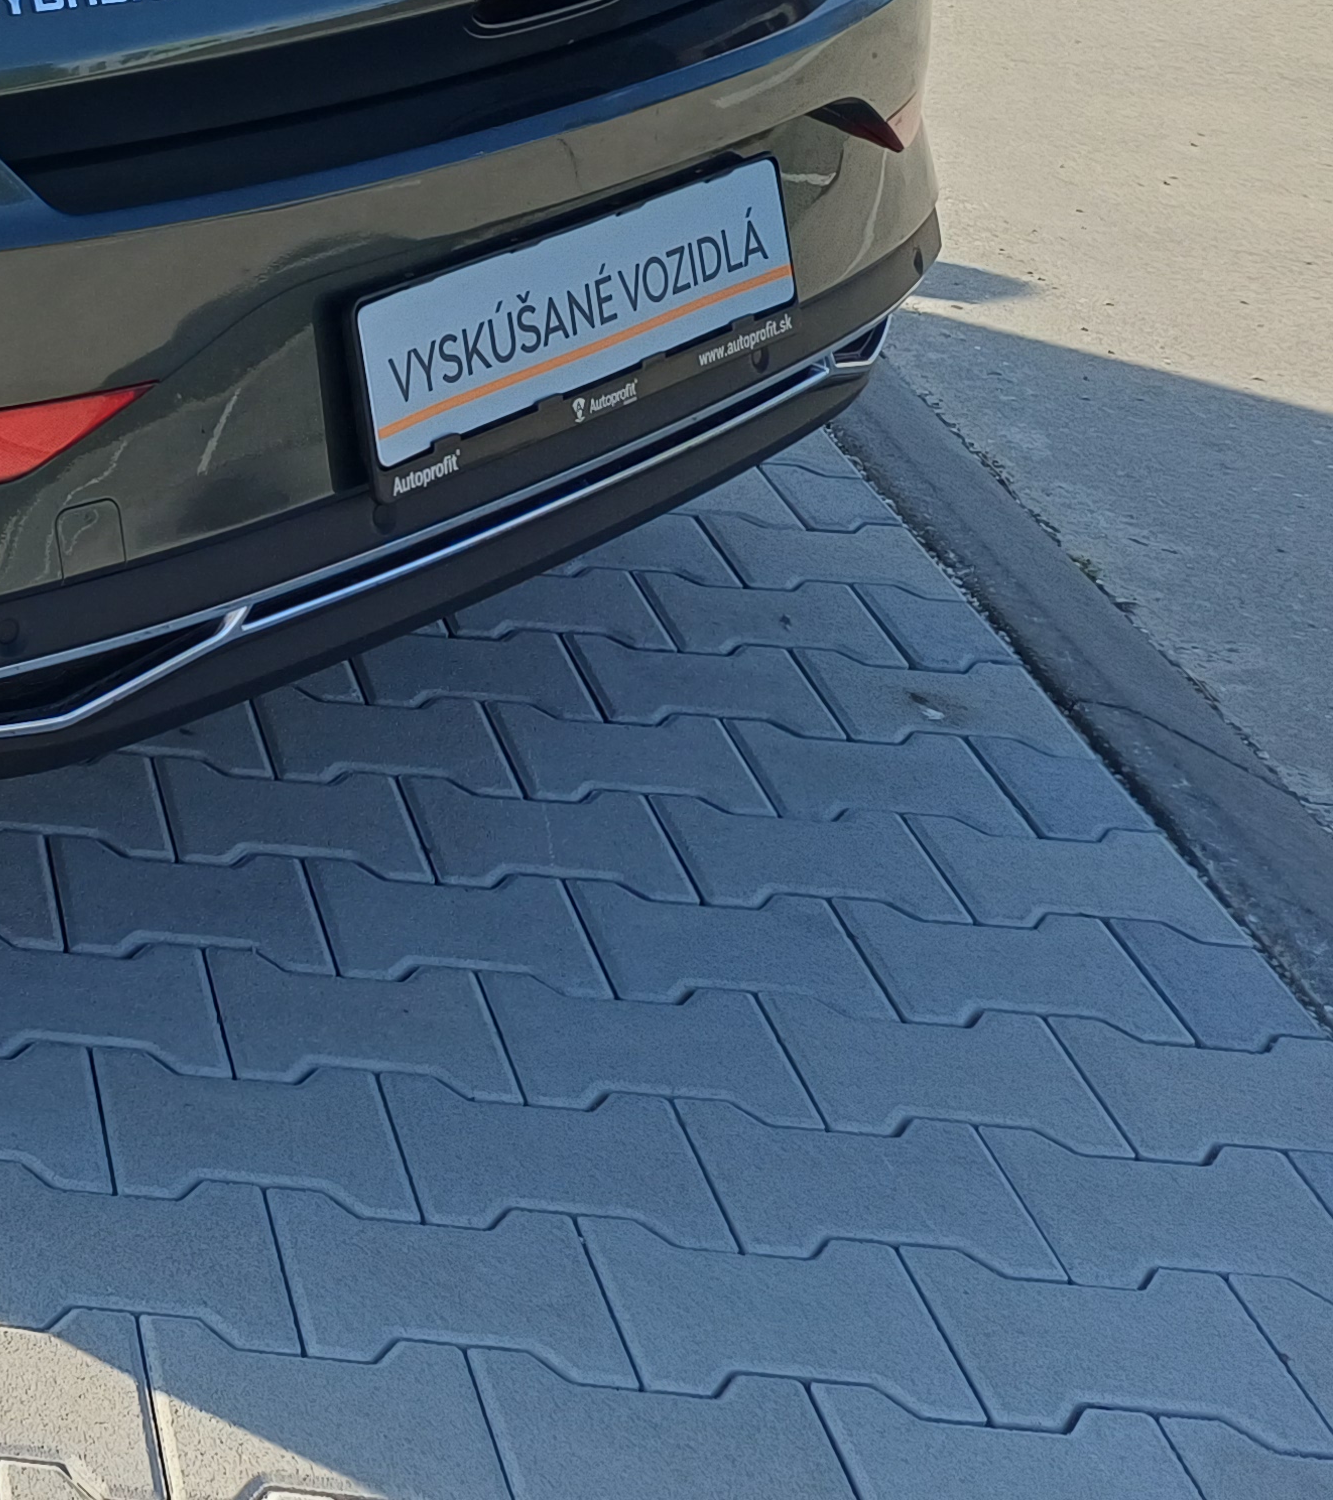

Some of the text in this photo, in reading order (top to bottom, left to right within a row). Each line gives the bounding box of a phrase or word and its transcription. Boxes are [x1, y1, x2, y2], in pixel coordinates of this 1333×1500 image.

[388, 206, 769, 402] VYSKÚŠANÉ VOZIDLÁ
[698, 313, 793, 367] www.autoprofit.sk
